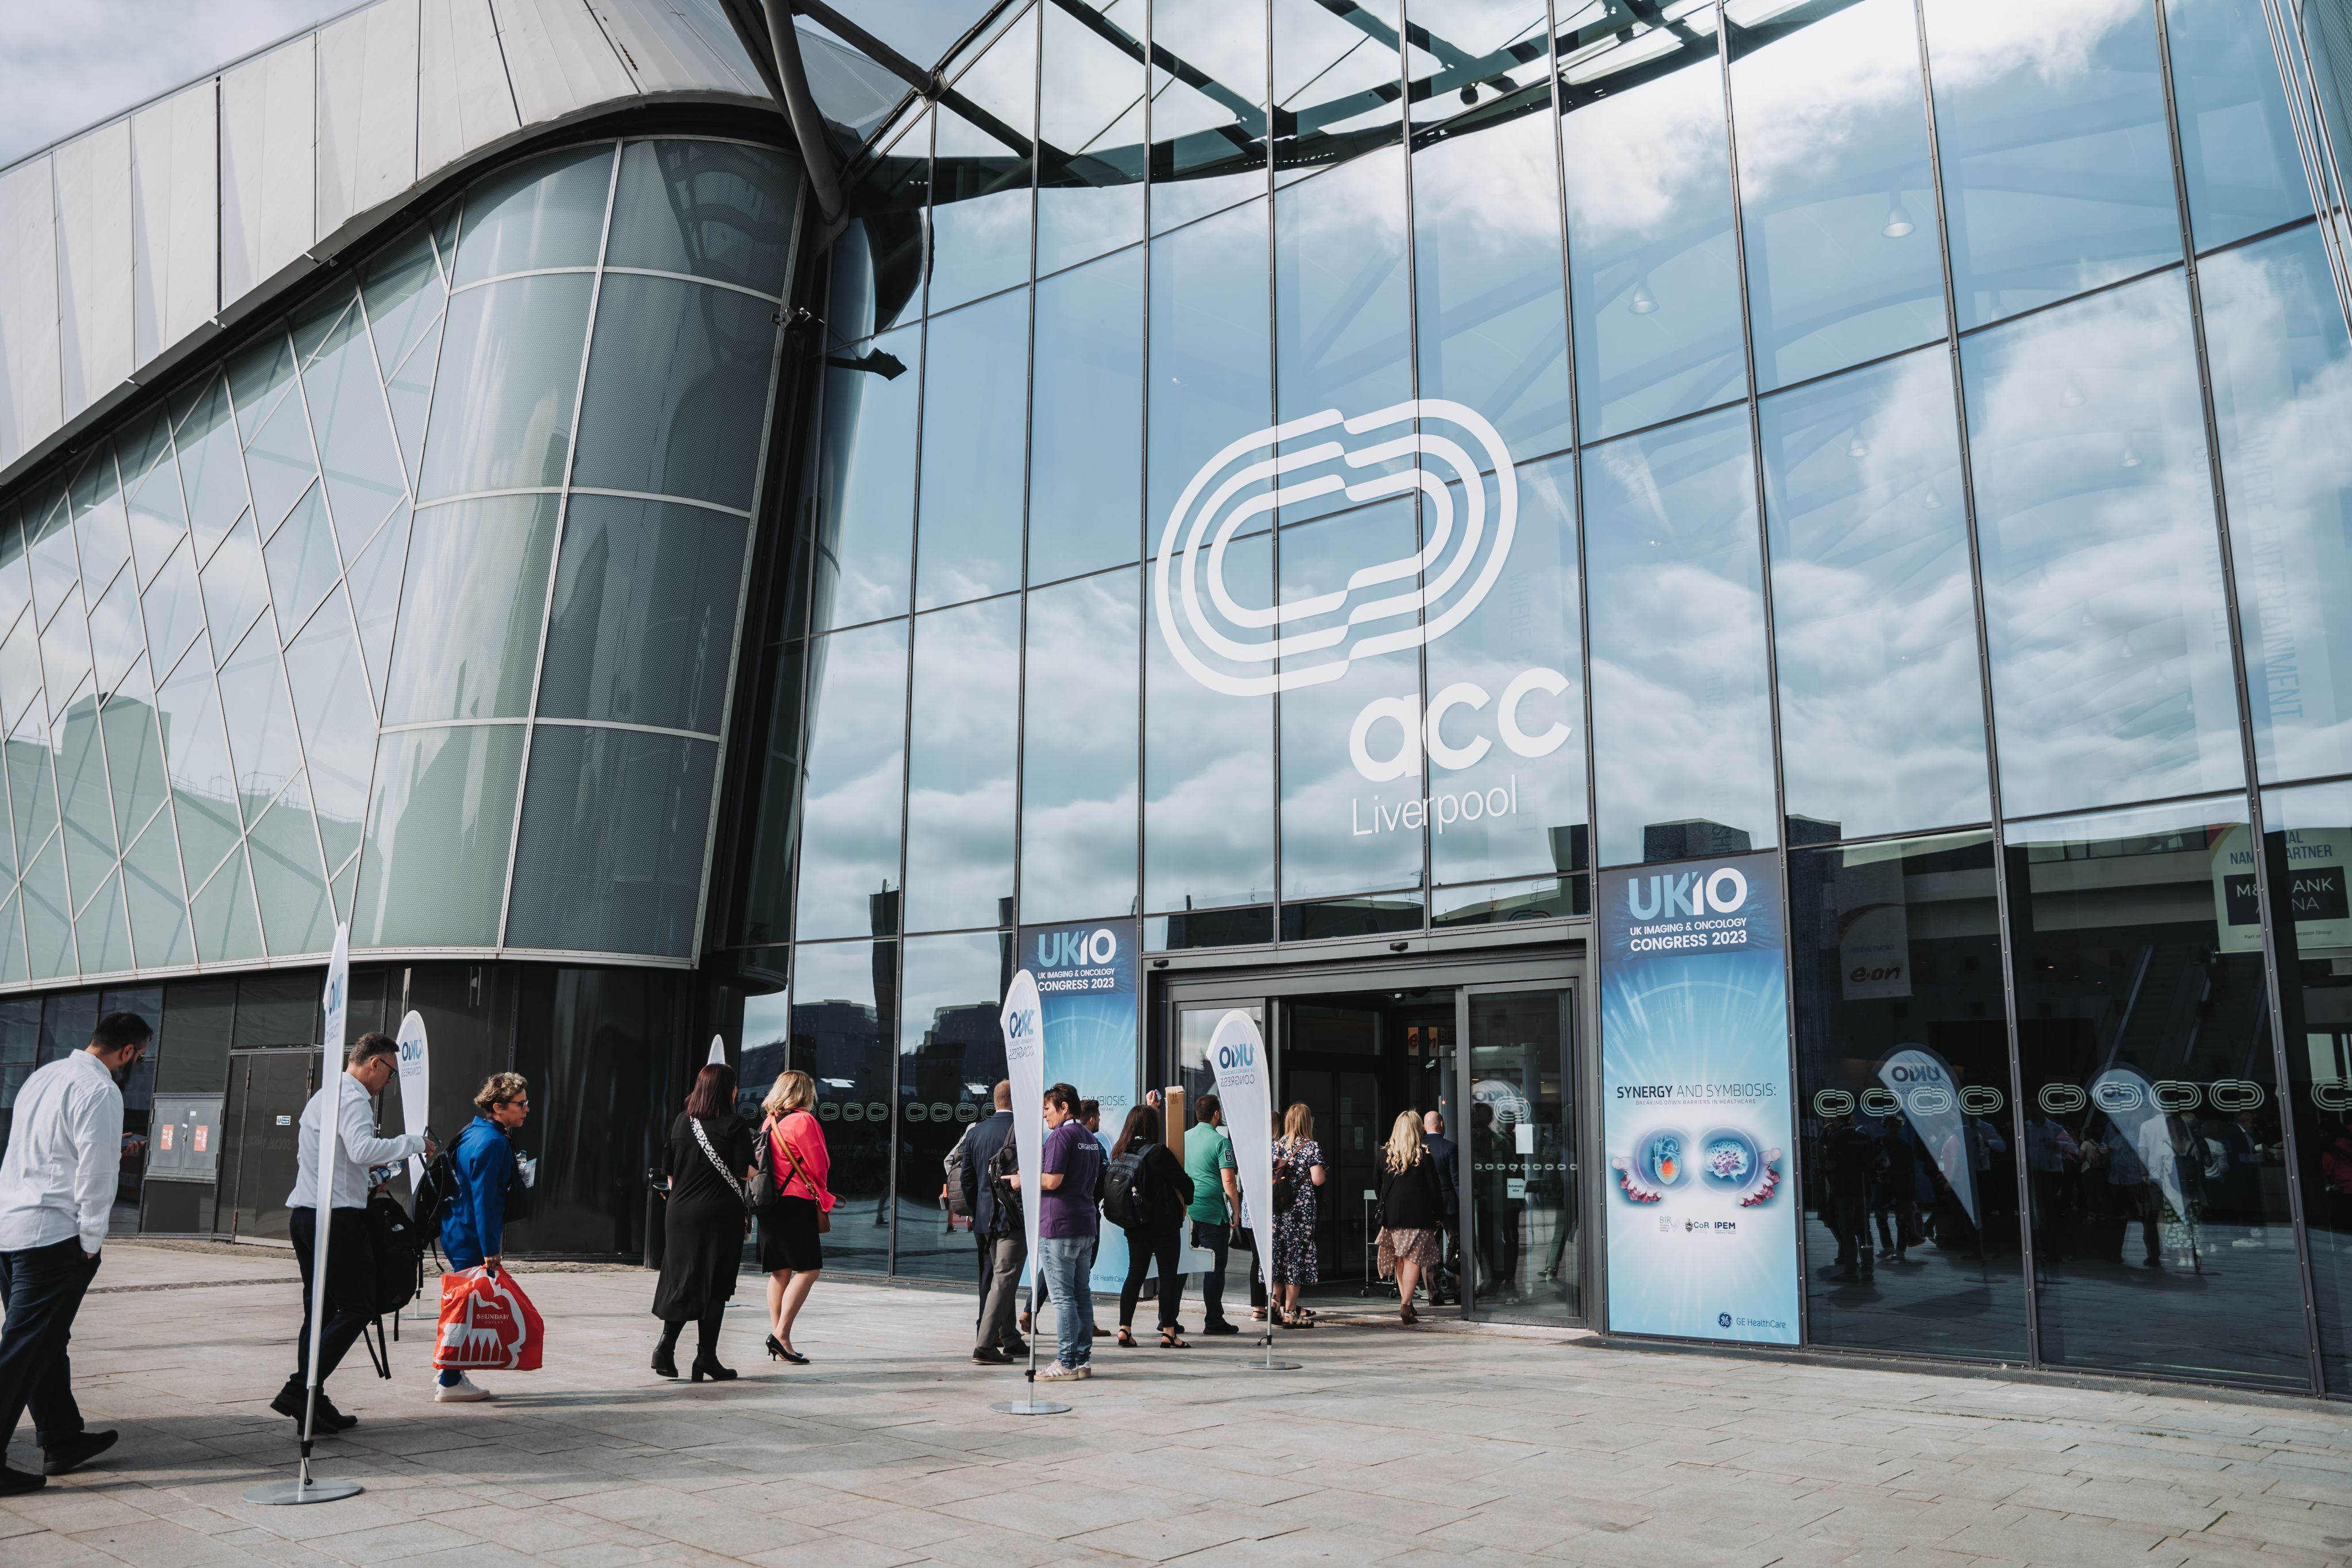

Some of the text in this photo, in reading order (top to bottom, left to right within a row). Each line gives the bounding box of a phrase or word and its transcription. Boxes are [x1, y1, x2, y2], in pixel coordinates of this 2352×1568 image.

[1349, 667, 1572, 782] acc
[1353, 774, 1517, 835] Liverpool
[2230, 851, 2254, 865] NAM
[2292, 877, 2334, 893] ANK
[1630, 917, 1747, 936] UK IMAGING & ONCOLOGY
[1630, 930, 1747, 951] CONGRESS 2023
[1047, 970, 1073, 979] IMAGING
[1080, 968, 1115, 976] ONCOLOGY
[1038, 977, 1114, 992] CONGRESS 2023
[1616, 1083, 1777, 1098] SYNERGY AND SYMBIOSIS:
[1736, 1318, 1786, 1329] GE HealthCare
